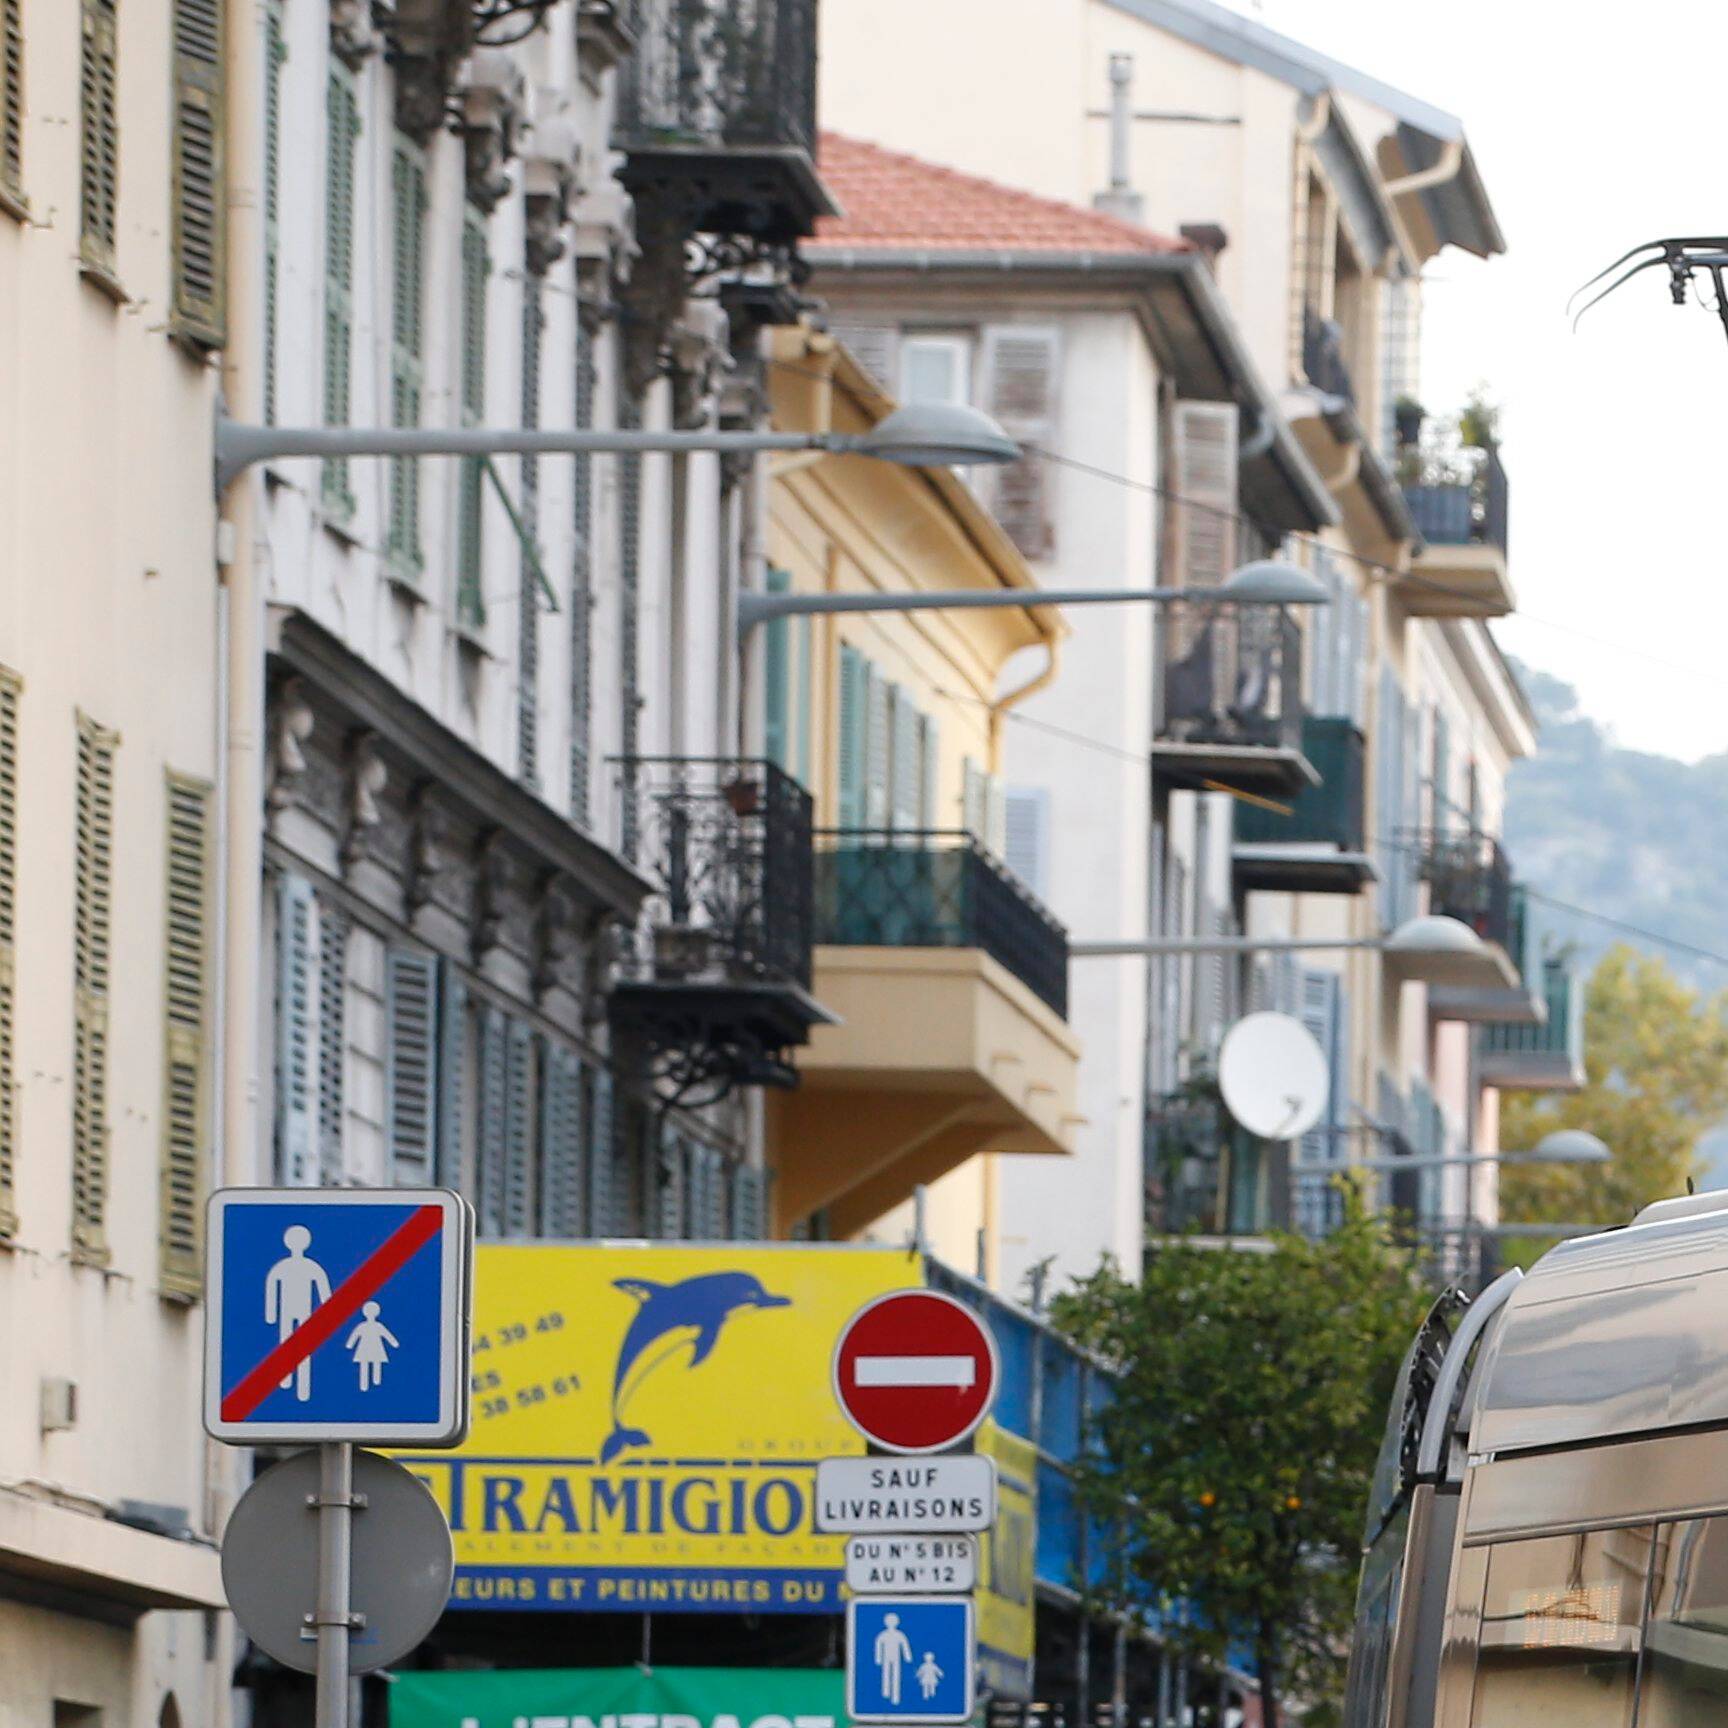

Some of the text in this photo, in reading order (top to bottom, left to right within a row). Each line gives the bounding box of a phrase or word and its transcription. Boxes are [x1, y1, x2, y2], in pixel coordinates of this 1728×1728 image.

[871, 1468, 939, 1488] SAUF
[825, 1498, 983, 1520] LIVRAISONS
[854, 1543, 881, 1559] DU
[917, 1543, 927, 1559] 5
[933, 1543, 969, 1559] BIS
[869, 1568, 895, 1582] AU
[933, 1567, 955, 1582] 12
[549, 1578, 586, 1600] ET
[597, 1578, 771, 1602] PEINTURES
[782, 1580, 825, 1601] DU
